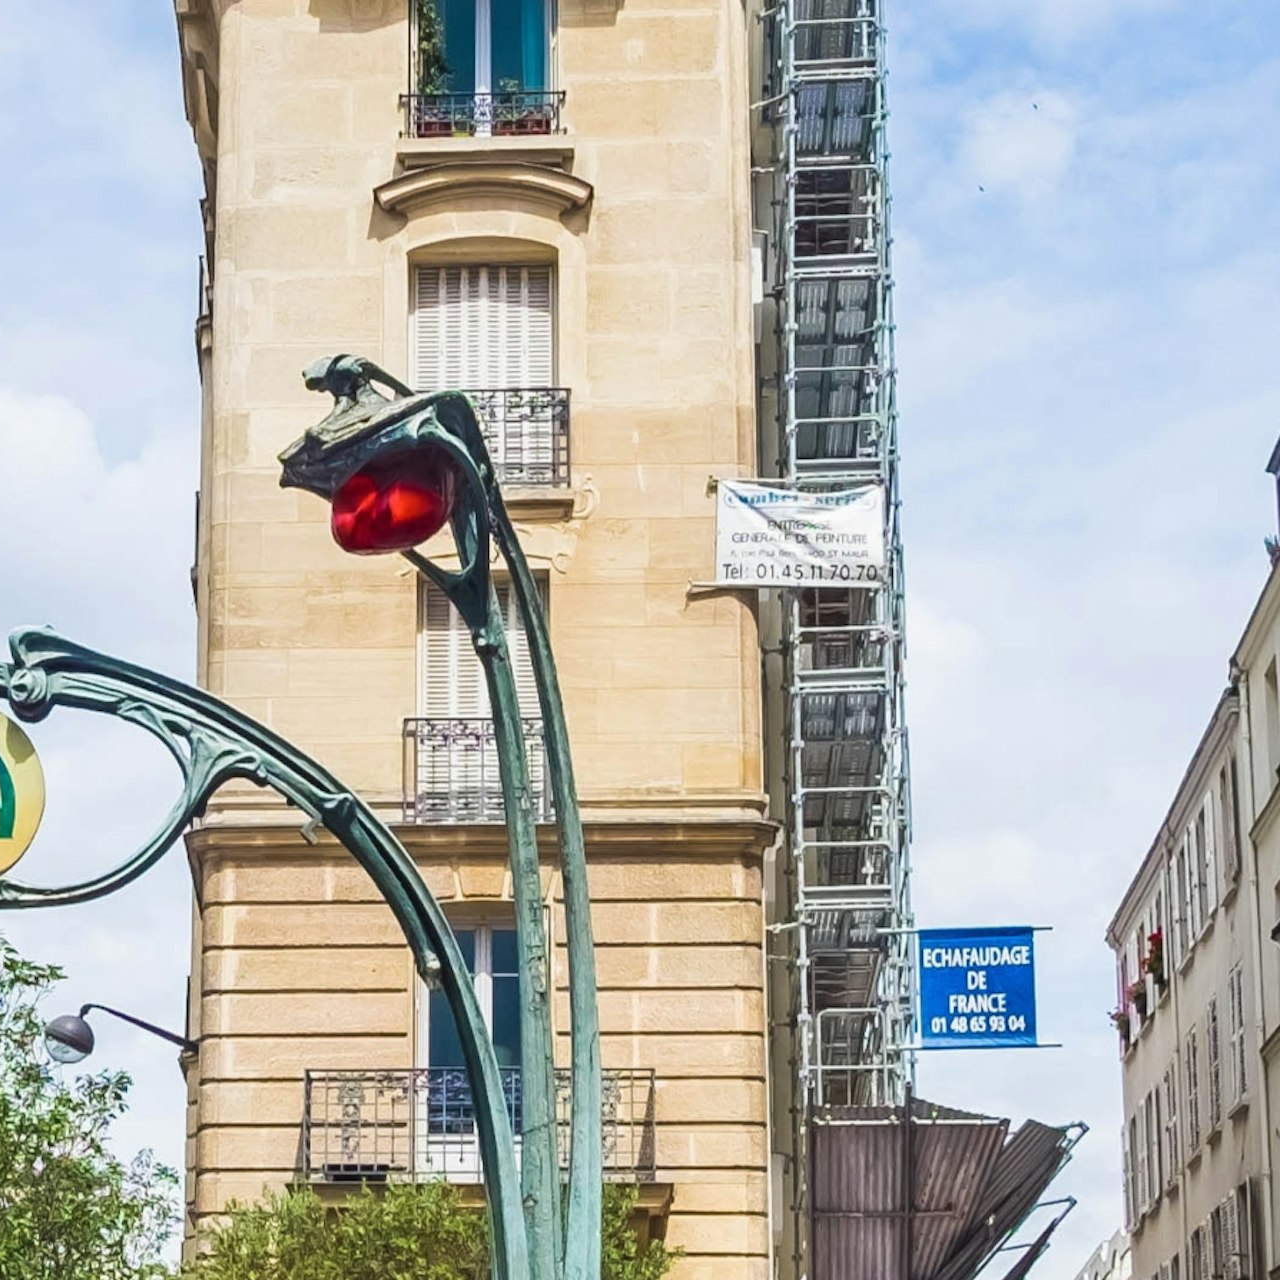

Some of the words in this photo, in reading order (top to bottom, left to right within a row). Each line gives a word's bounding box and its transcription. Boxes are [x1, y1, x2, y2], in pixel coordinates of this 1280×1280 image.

[816, 533, 868, 544] PEINTURE
[756, 563, 878, 581] 01.45.11.70.70
[923, 946, 1030, 968] ECHAFAUDAGE
[967, 970, 987, 990] DE
[949, 993, 1007, 1014] FRANCE
[931, 1017, 947, 1033] 01
[950, 1016, 968, 1033] 48
[970, 1016, 987, 1032] 65
[989, 1015, 1006, 1032] 93
[1008, 1014, 1025, 1032] 04
